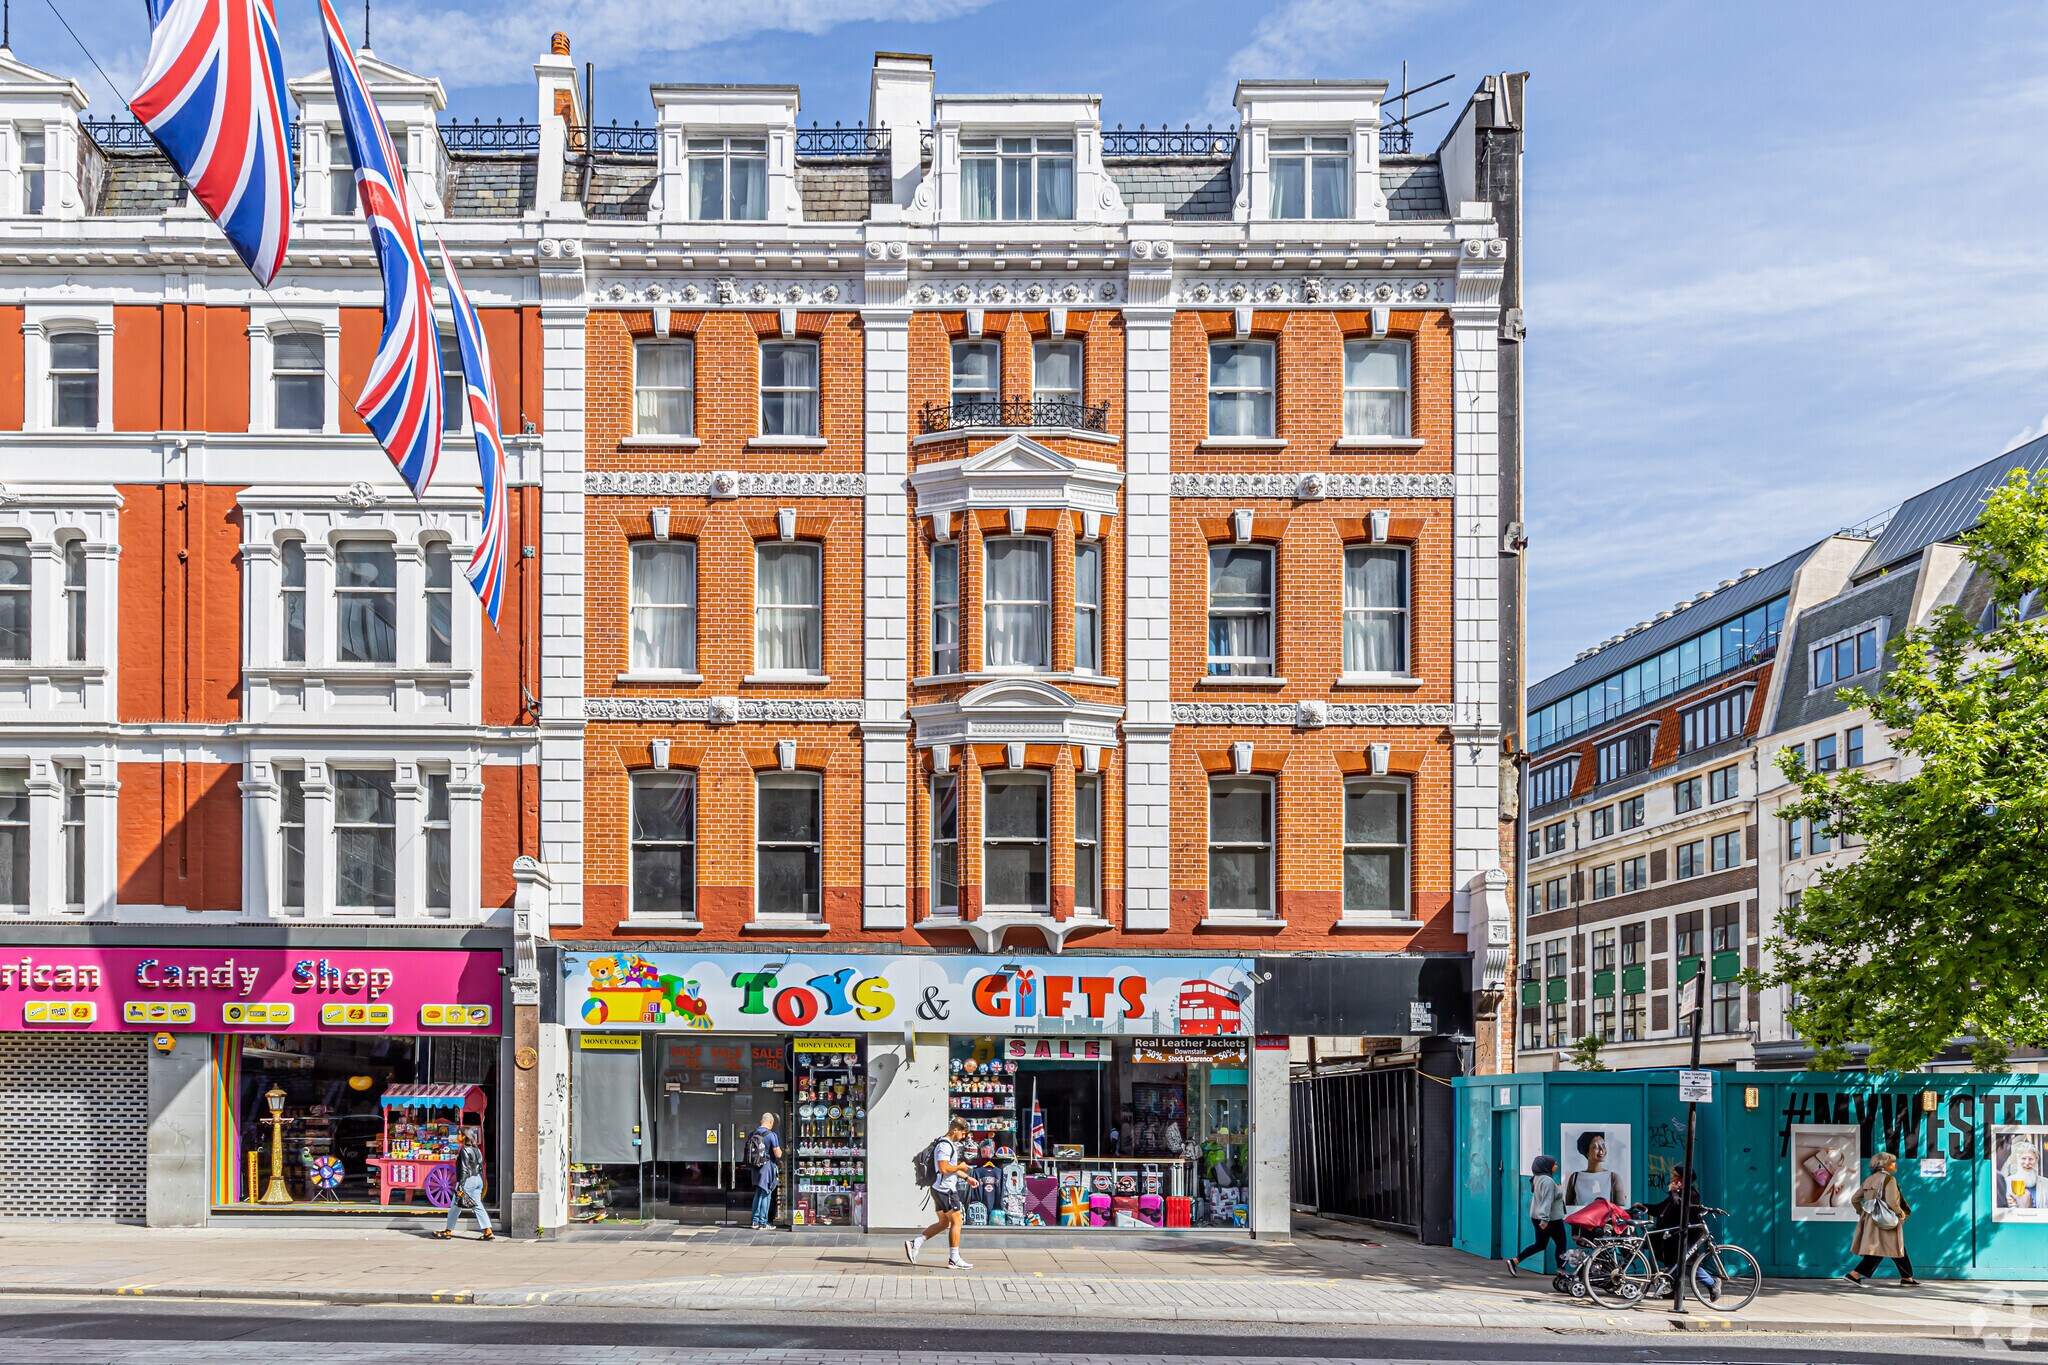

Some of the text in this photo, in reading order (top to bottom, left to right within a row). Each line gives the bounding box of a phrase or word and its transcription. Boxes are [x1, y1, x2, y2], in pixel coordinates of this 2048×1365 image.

[1, 956, 393, 998] rican Candy Shop
[731, 967, 896, 1027] TOYS
[915, 985, 950, 1021] &
[584, 1038, 639, 1046] MONEY CHANGE
[1135, 1038, 1159, 1048] Real
[1162, 1038, 1204, 1048] Leather
[1206, 1038, 1246, 1048] Jackets
[671, 1046, 702, 1057] SALE
[711, 1047, 742, 1058] SALE
[752, 1047, 783, 1058] SALE
[1009, 1039, 1100, 1059] SALE
